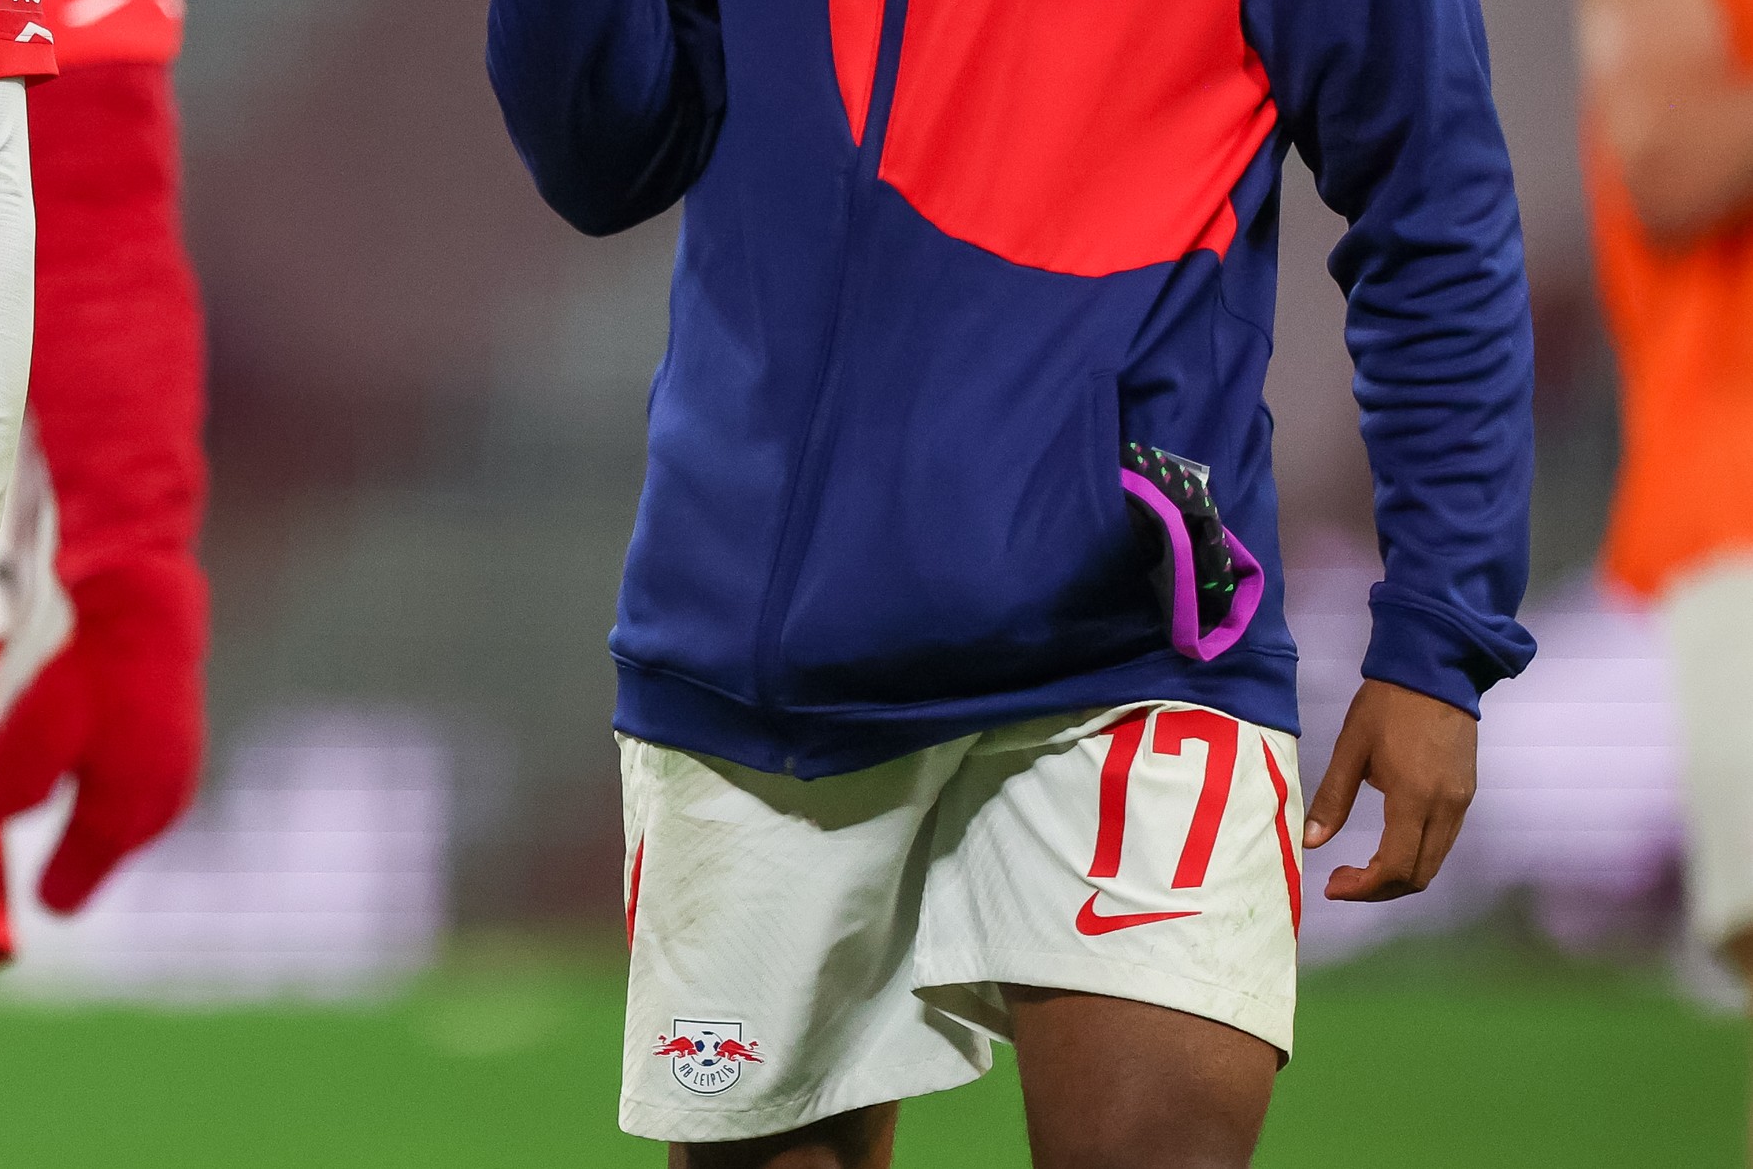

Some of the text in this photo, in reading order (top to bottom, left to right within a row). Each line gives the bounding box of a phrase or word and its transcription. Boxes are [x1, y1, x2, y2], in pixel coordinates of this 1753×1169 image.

[1086, 706, 1239, 889] 17
[678, 1063, 735, 1086] RB LEIPZIG
